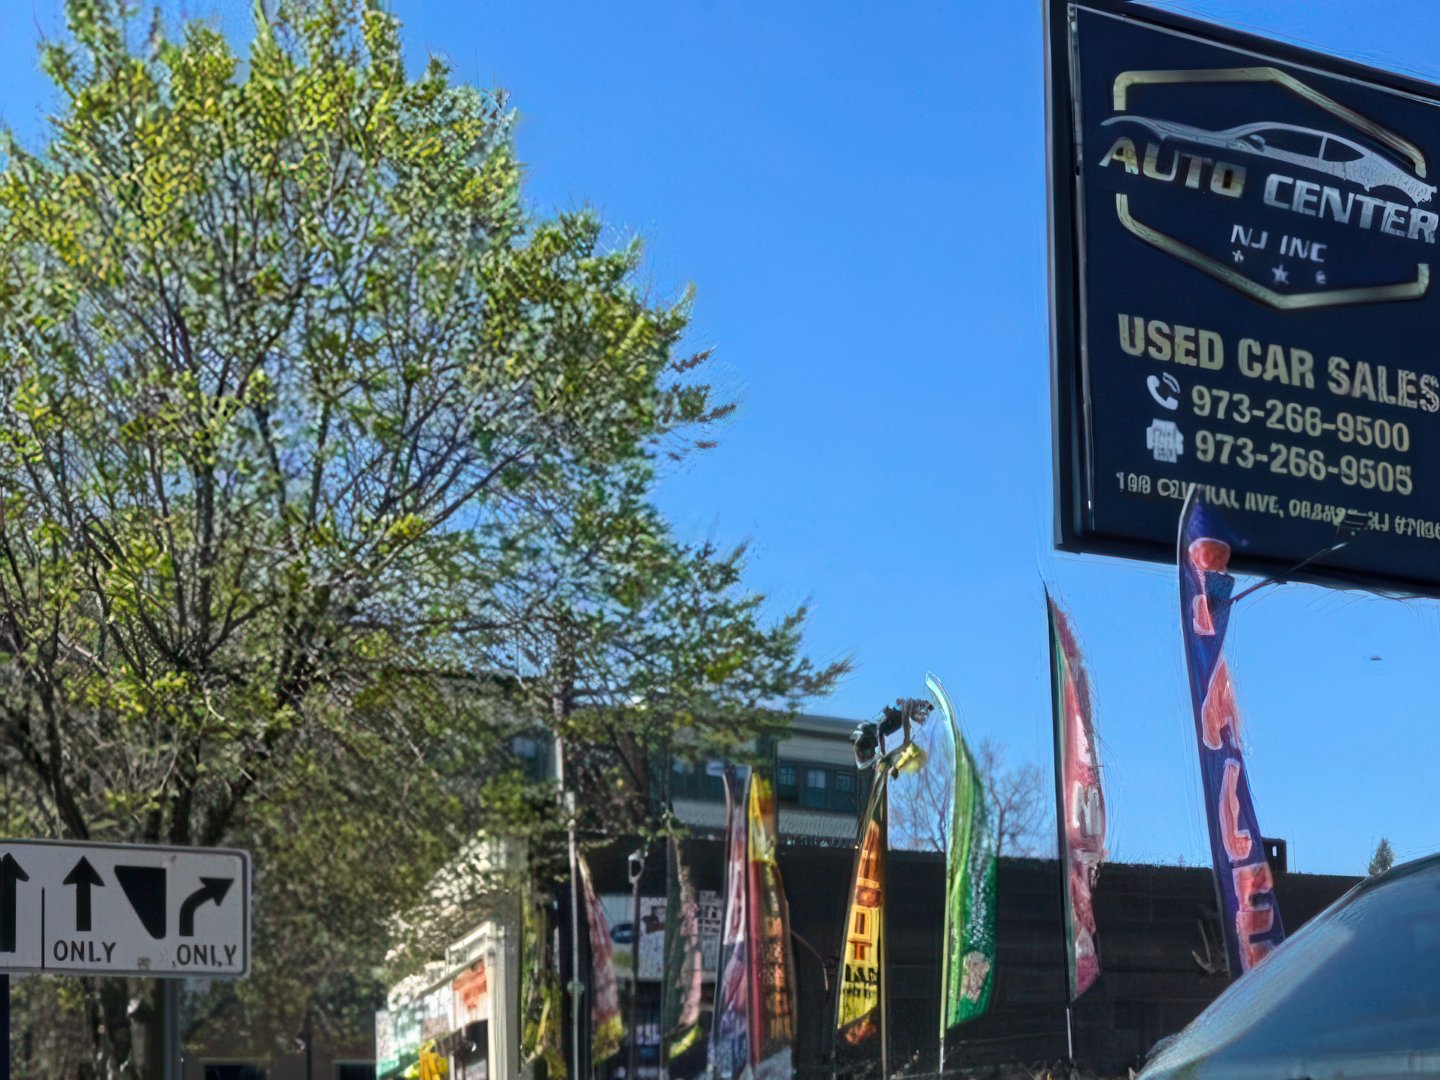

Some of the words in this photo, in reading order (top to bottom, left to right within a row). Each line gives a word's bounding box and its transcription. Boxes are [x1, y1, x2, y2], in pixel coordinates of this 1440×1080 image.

[1099, 136, 1248, 199] AUTO
[1263, 172, 1440, 244] CENTER
[1230, 224, 1269, 250] NJ
[1279, 234, 1328, 263] INC
[1117, 313, 1224, 371] USED
[1237, 338, 1315, 389] CAR
[1326, 356, 1440, 413] SALES
[1191, 385, 1411, 452] 973-266-9500
[53, 939, 117, 964] ONLY
[175, 943, 238, 967] ONLY
